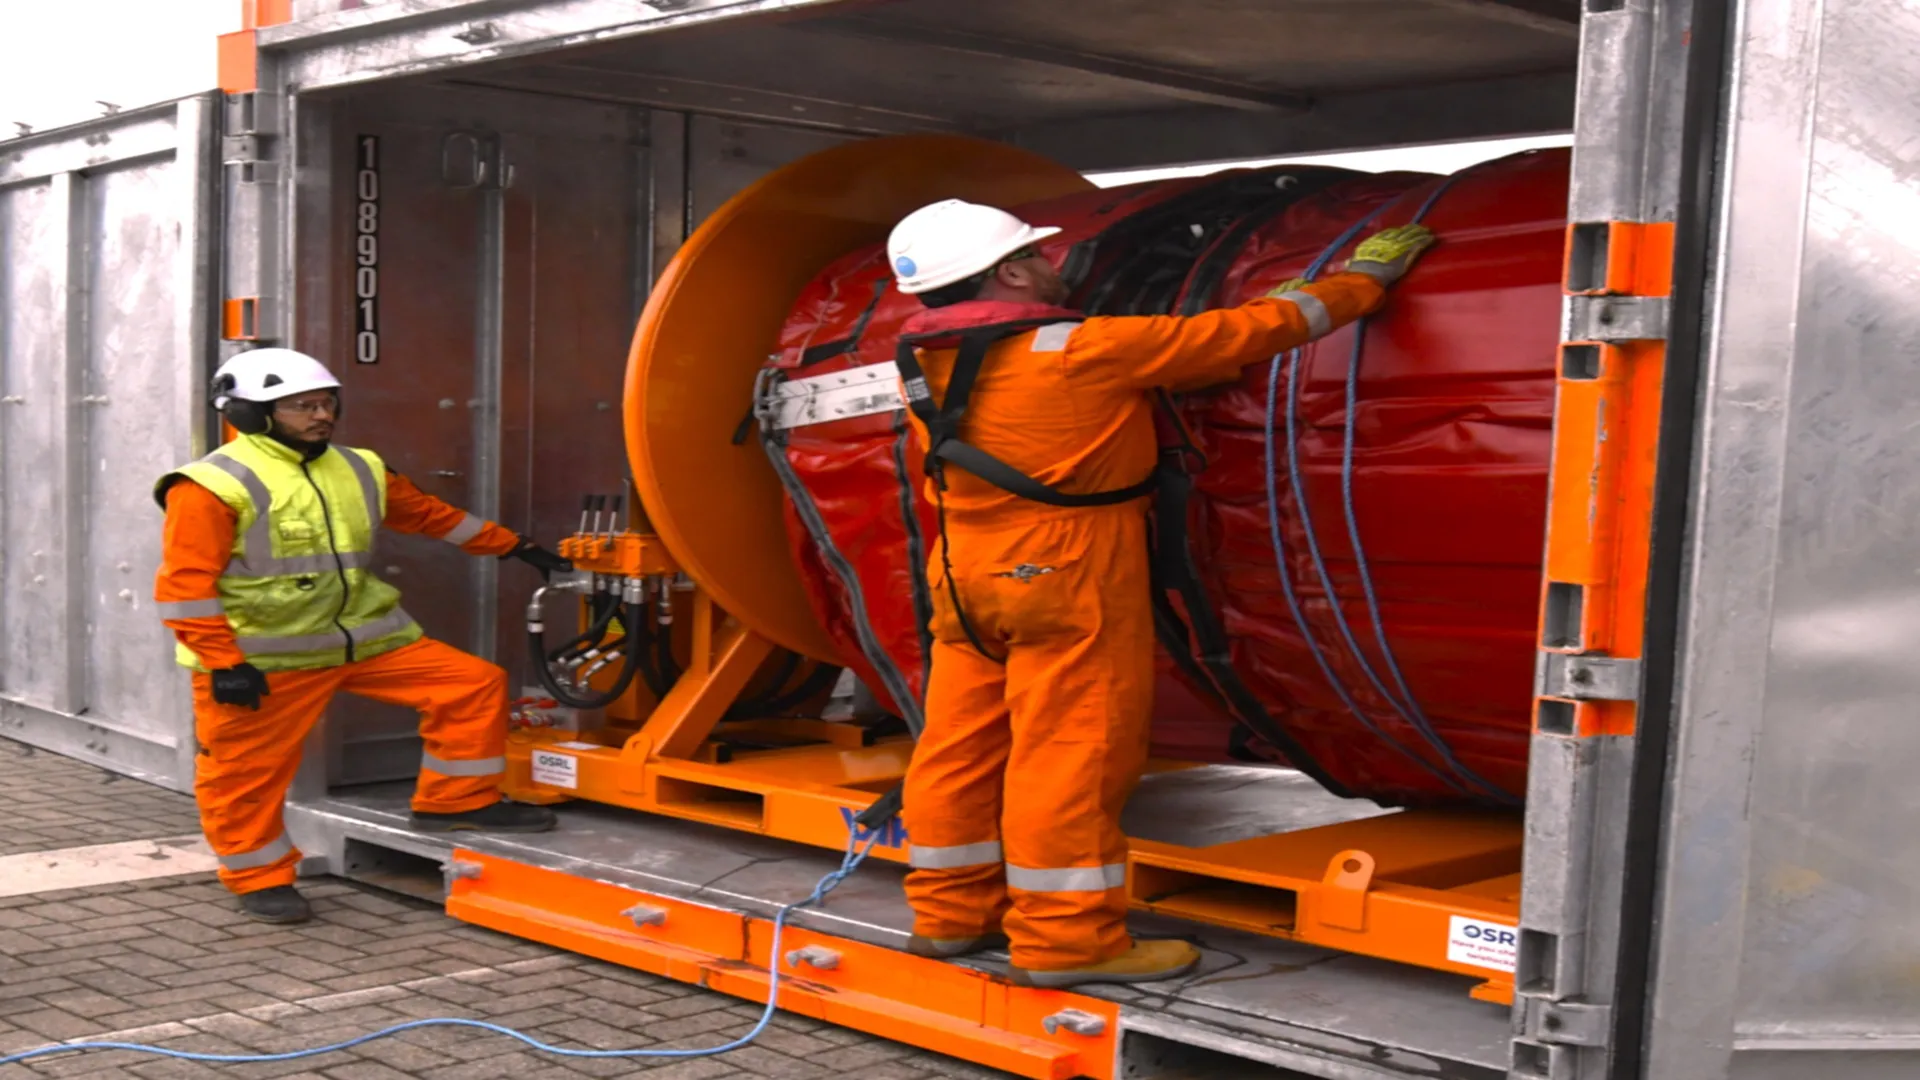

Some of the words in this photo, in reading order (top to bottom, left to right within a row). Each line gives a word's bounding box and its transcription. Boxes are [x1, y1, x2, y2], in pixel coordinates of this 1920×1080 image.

[357, 137, 378, 363] 1089010
[537, 755, 573, 770] OSRL
[839, 806, 908, 849] VIK
[1463, 924, 1516, 947] OSR
